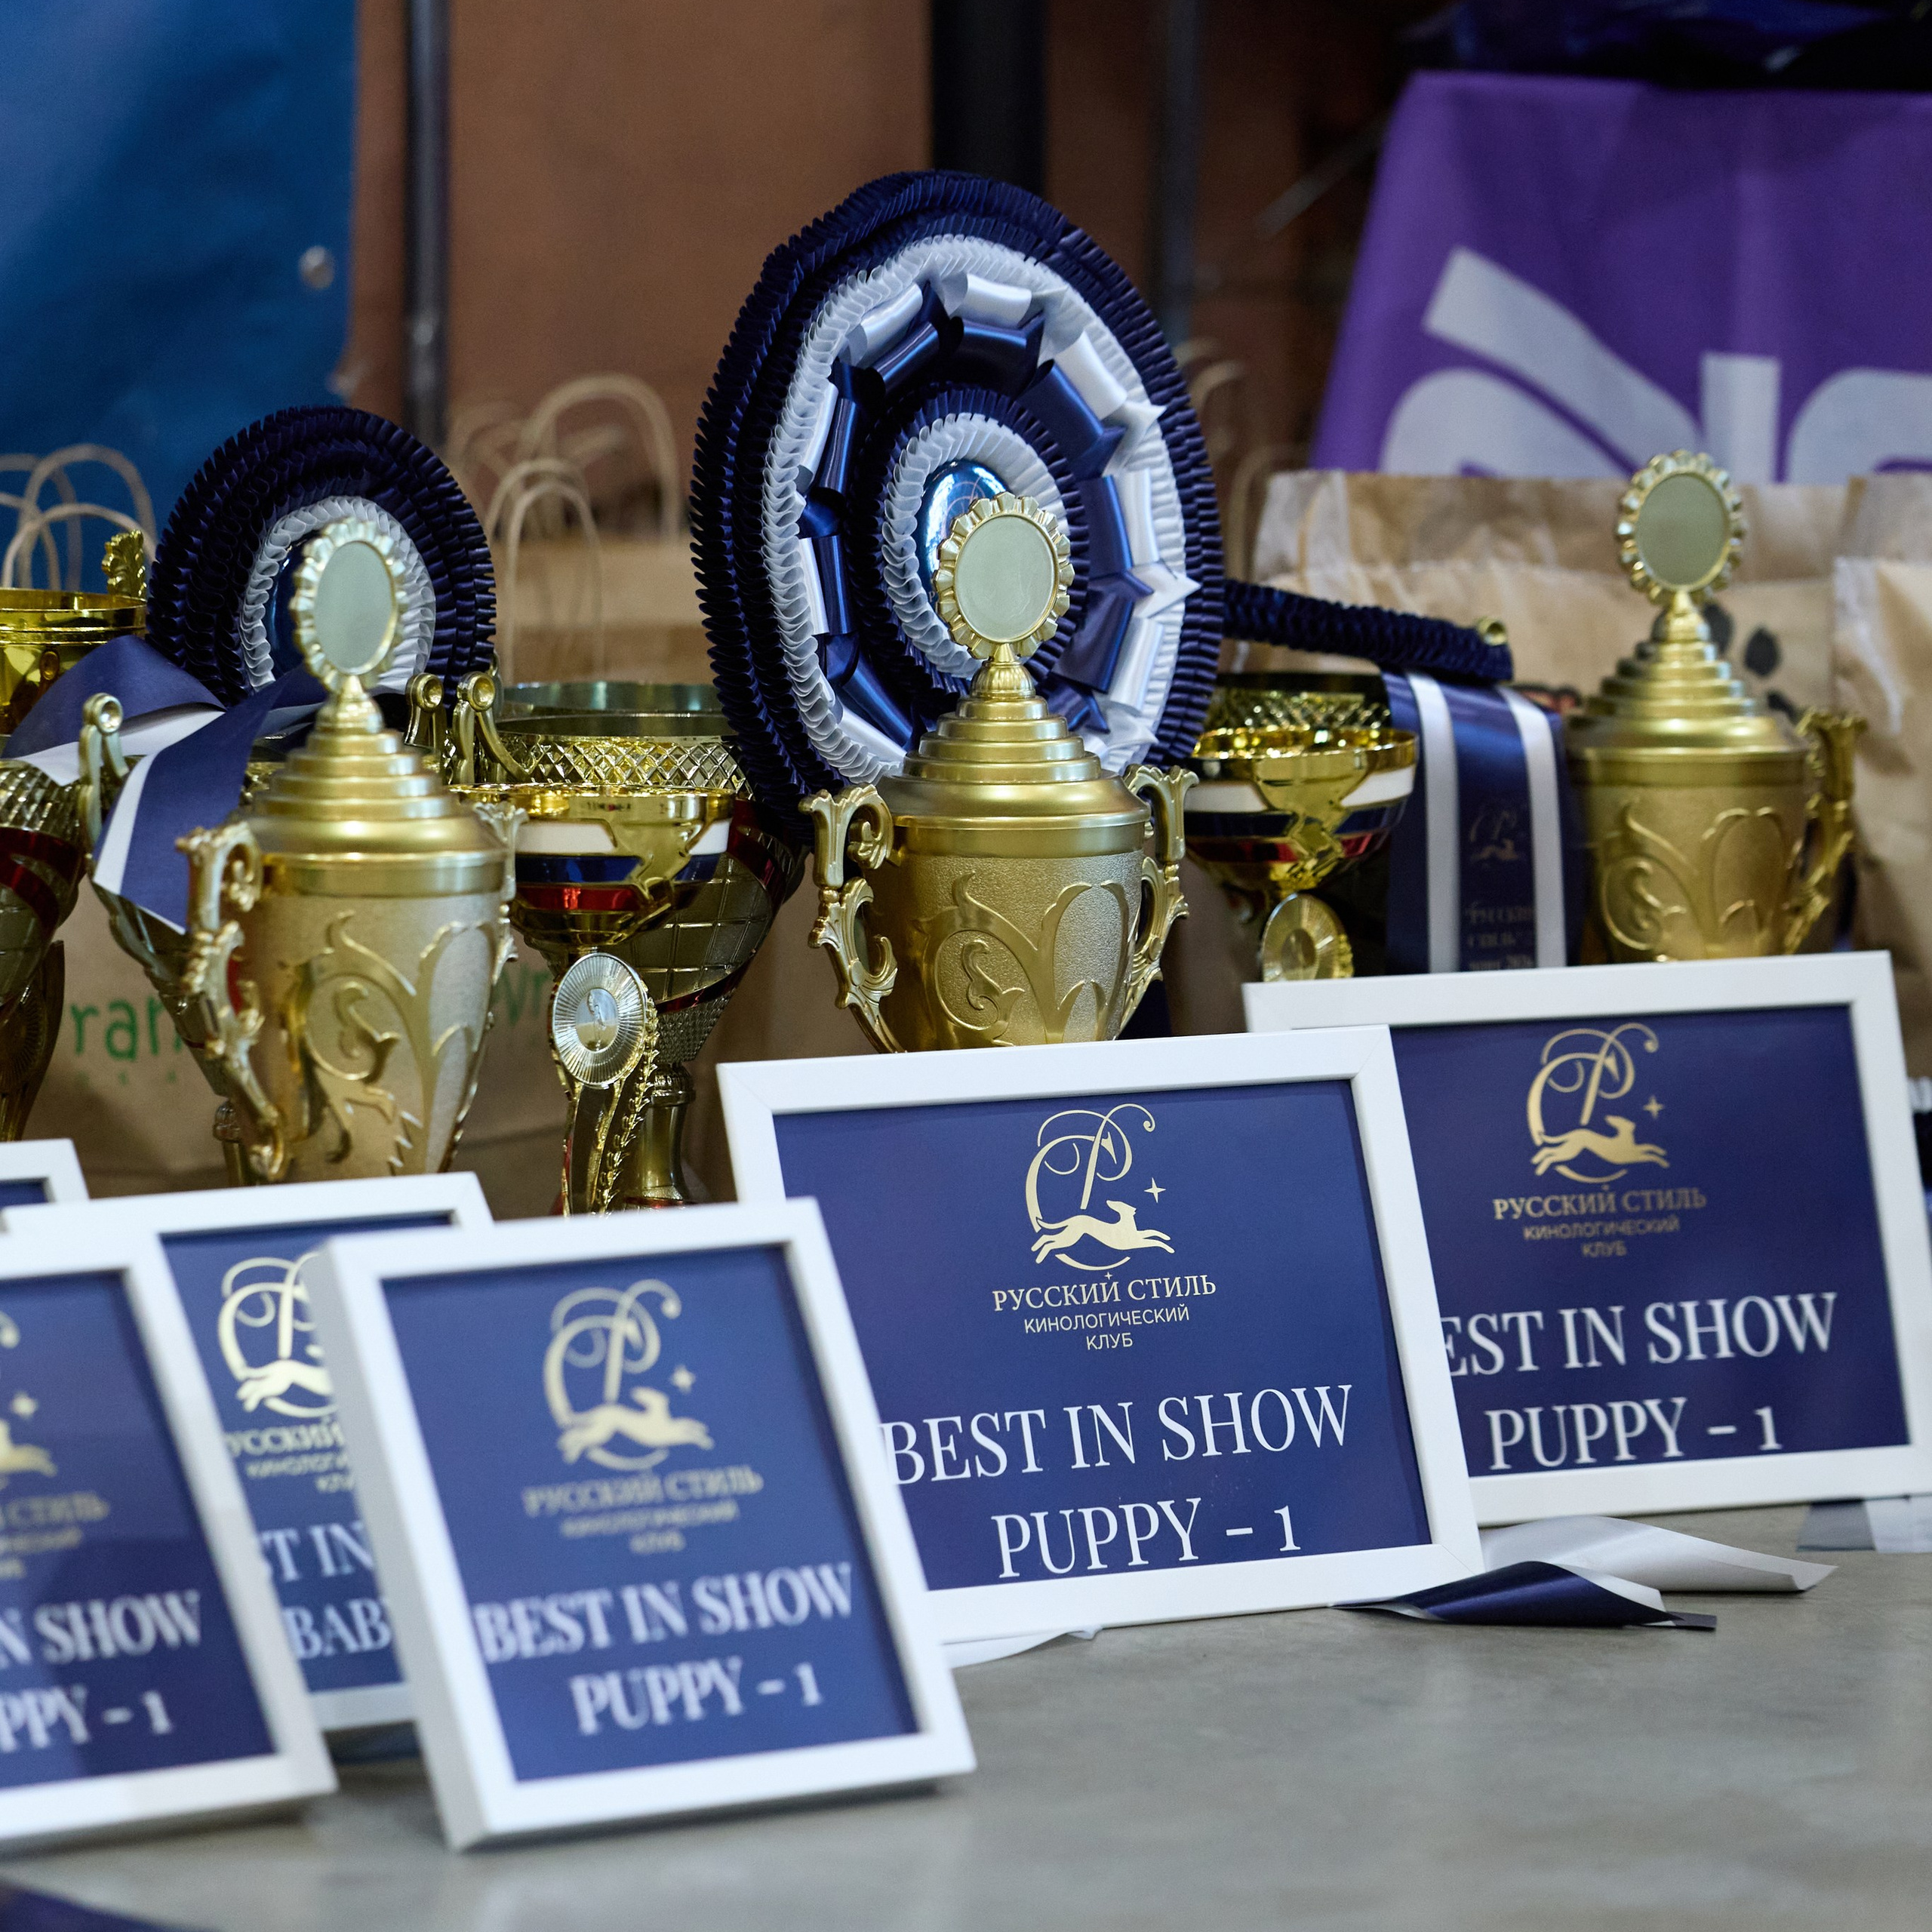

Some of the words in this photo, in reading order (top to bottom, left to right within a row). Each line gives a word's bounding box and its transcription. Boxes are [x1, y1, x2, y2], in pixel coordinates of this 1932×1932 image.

[1492, 1186, 1617, 1220] РУССКИЙ
[1622, 1187, 1706, 1212] СТИЛЬ
[992, 1274, 1121, 1311] РУССКИЙ
[1128, 1275, 1217, 1300] СТИЛЬ
[1024, 1303, 1189, 1334] КИНОЛОГИЧЕСКИЙ
[1087, 1332, 1133, 1350] КЛУБ
[1440, 1310, 1544, 1377] EST
[1557, 1306, 1626, 1368] IN
[1644, 1291, 1838, 1364] SHOW
[880, 1409, 1047, 1484] BEST
[1063, 1401, 1135, 1469] IN
[1158, 1385, 1352, 1462] SHOW
[1483, 1397, 1687, 1471] PUPPY
[1754, 1406, 1783, 1451] 1
[991, 1497, 1202, 1578] PUPPY
[1274, 1506, 1300, 1552] 1
[34, 1589, 202, 1664] SHOW
[284, 1598, 392, 1660] BAB
[473, 1587, 614, 1663] BEST
[621, 1580, 688, 1644] IN
[691, 1561, 851, 1635] SHOW
[143, 1689, 174, 1734] 1
[569, 1655, 744, 1736] PUPPY
[795, 1661, 822, 1707] 1
